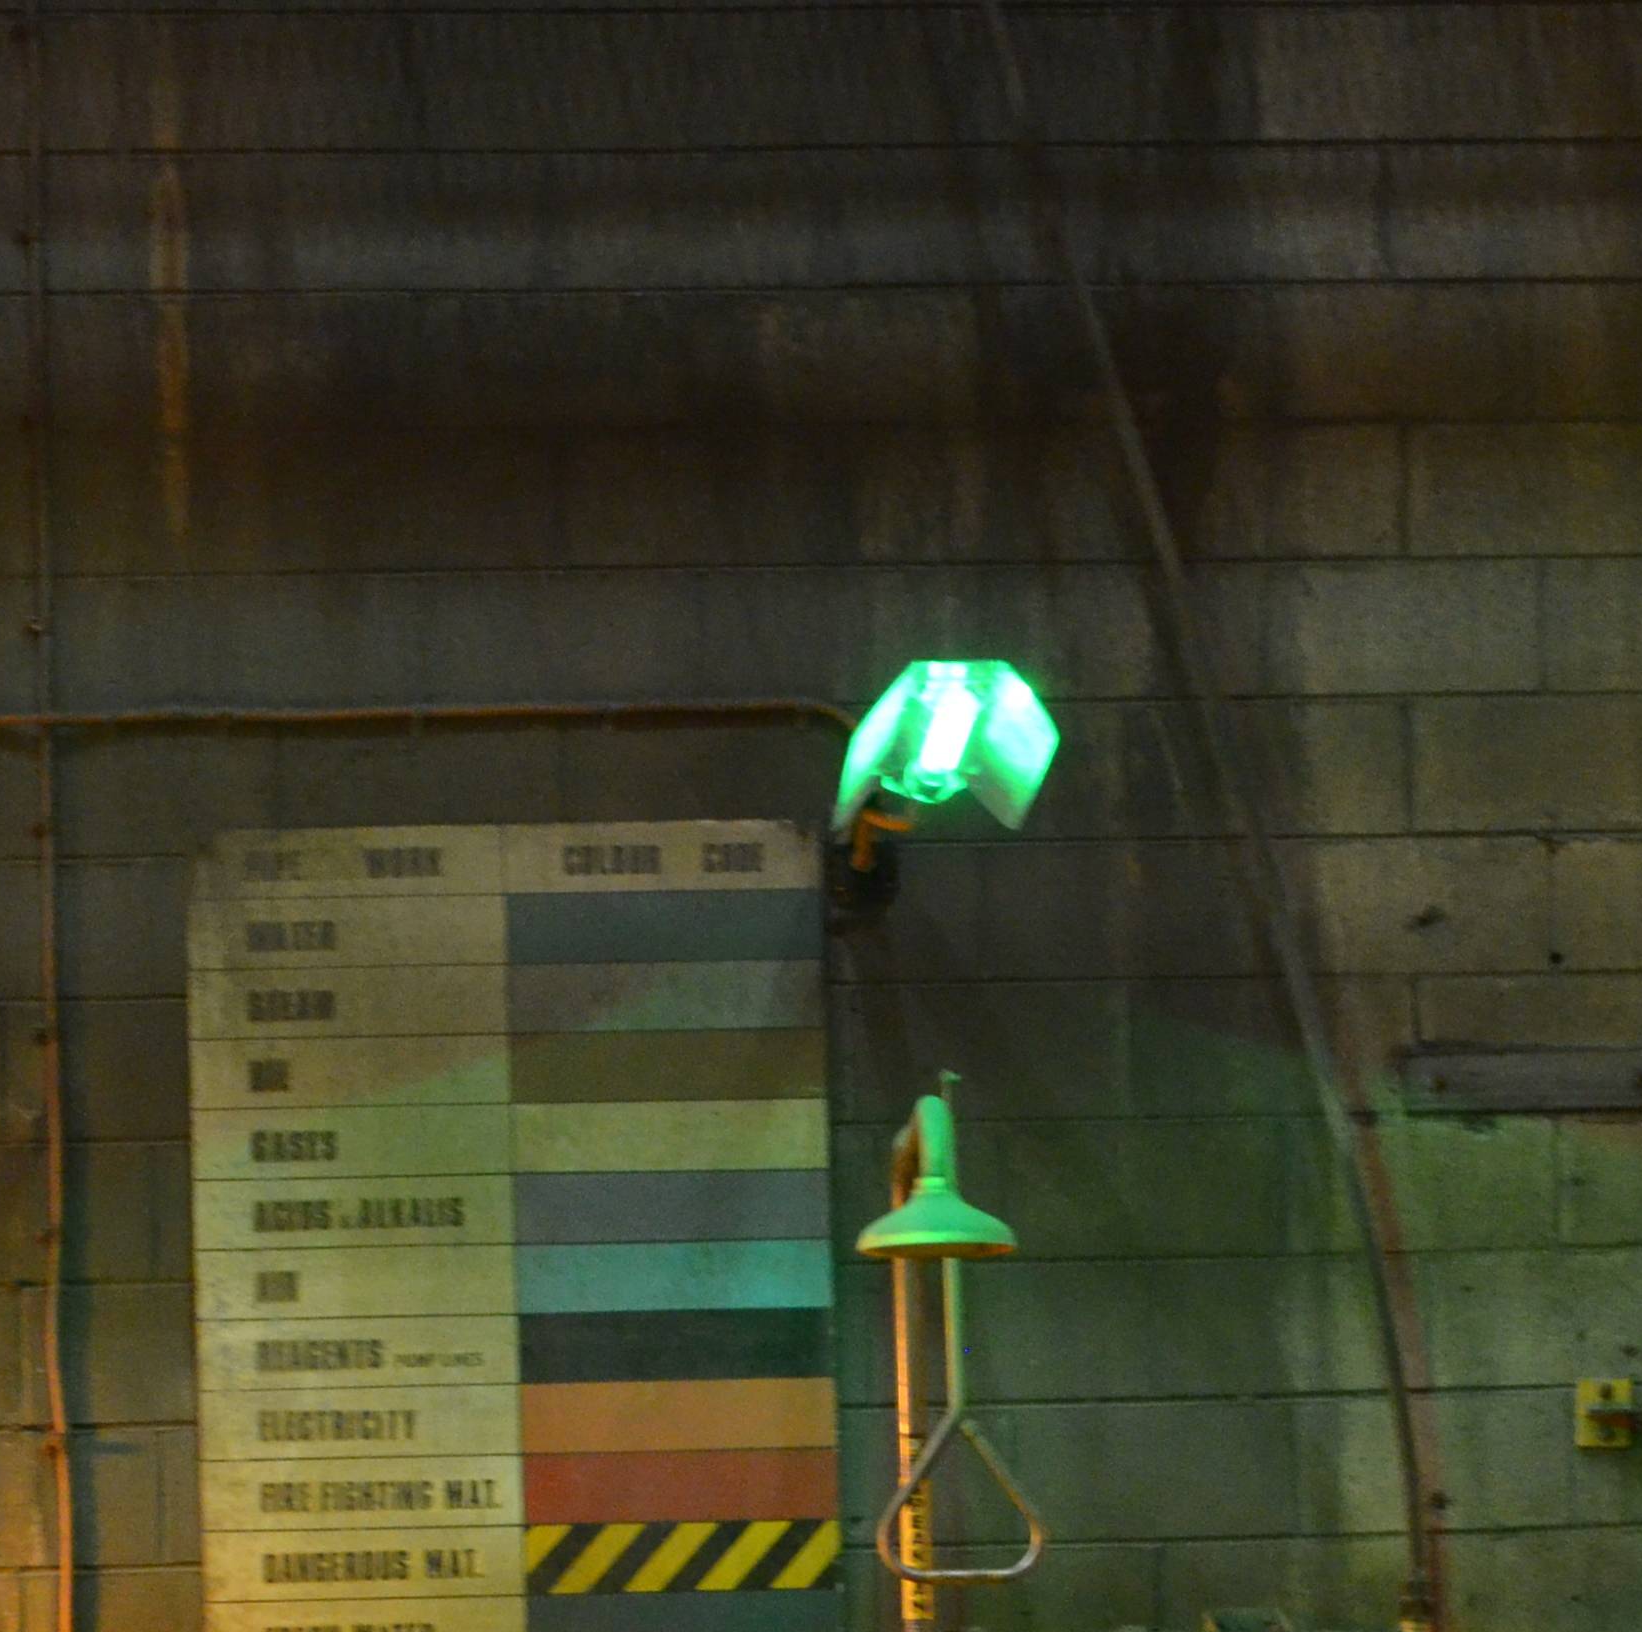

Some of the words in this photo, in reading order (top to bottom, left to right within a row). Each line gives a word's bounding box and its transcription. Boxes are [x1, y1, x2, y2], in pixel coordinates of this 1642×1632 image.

[363, 847, 442, 878] WORK
[563, 844, 661, 875] COLOUR
[703, 842, 764, 873] CODE
[246, 920, 336, 952] WATER
[251, 1130, 338, 1162] GASES
[254, 1199, 331, 1232] ACIDS
[357, 1197, 465, 1229] ALKALIS
[256, 1339, 384, 1371] REAGENTS
[258, 1409, 419, 1441] ELECTRICITY
[260, 1482, 311, 1513] FIRE
[319, 1480, 435, 1511] FIGHTING
[444, 1478, 502, 1509] MAT.
[262, 1551, 410, 1583] DANGEROUS
[425, 1549, 484, 1578] MAT.
